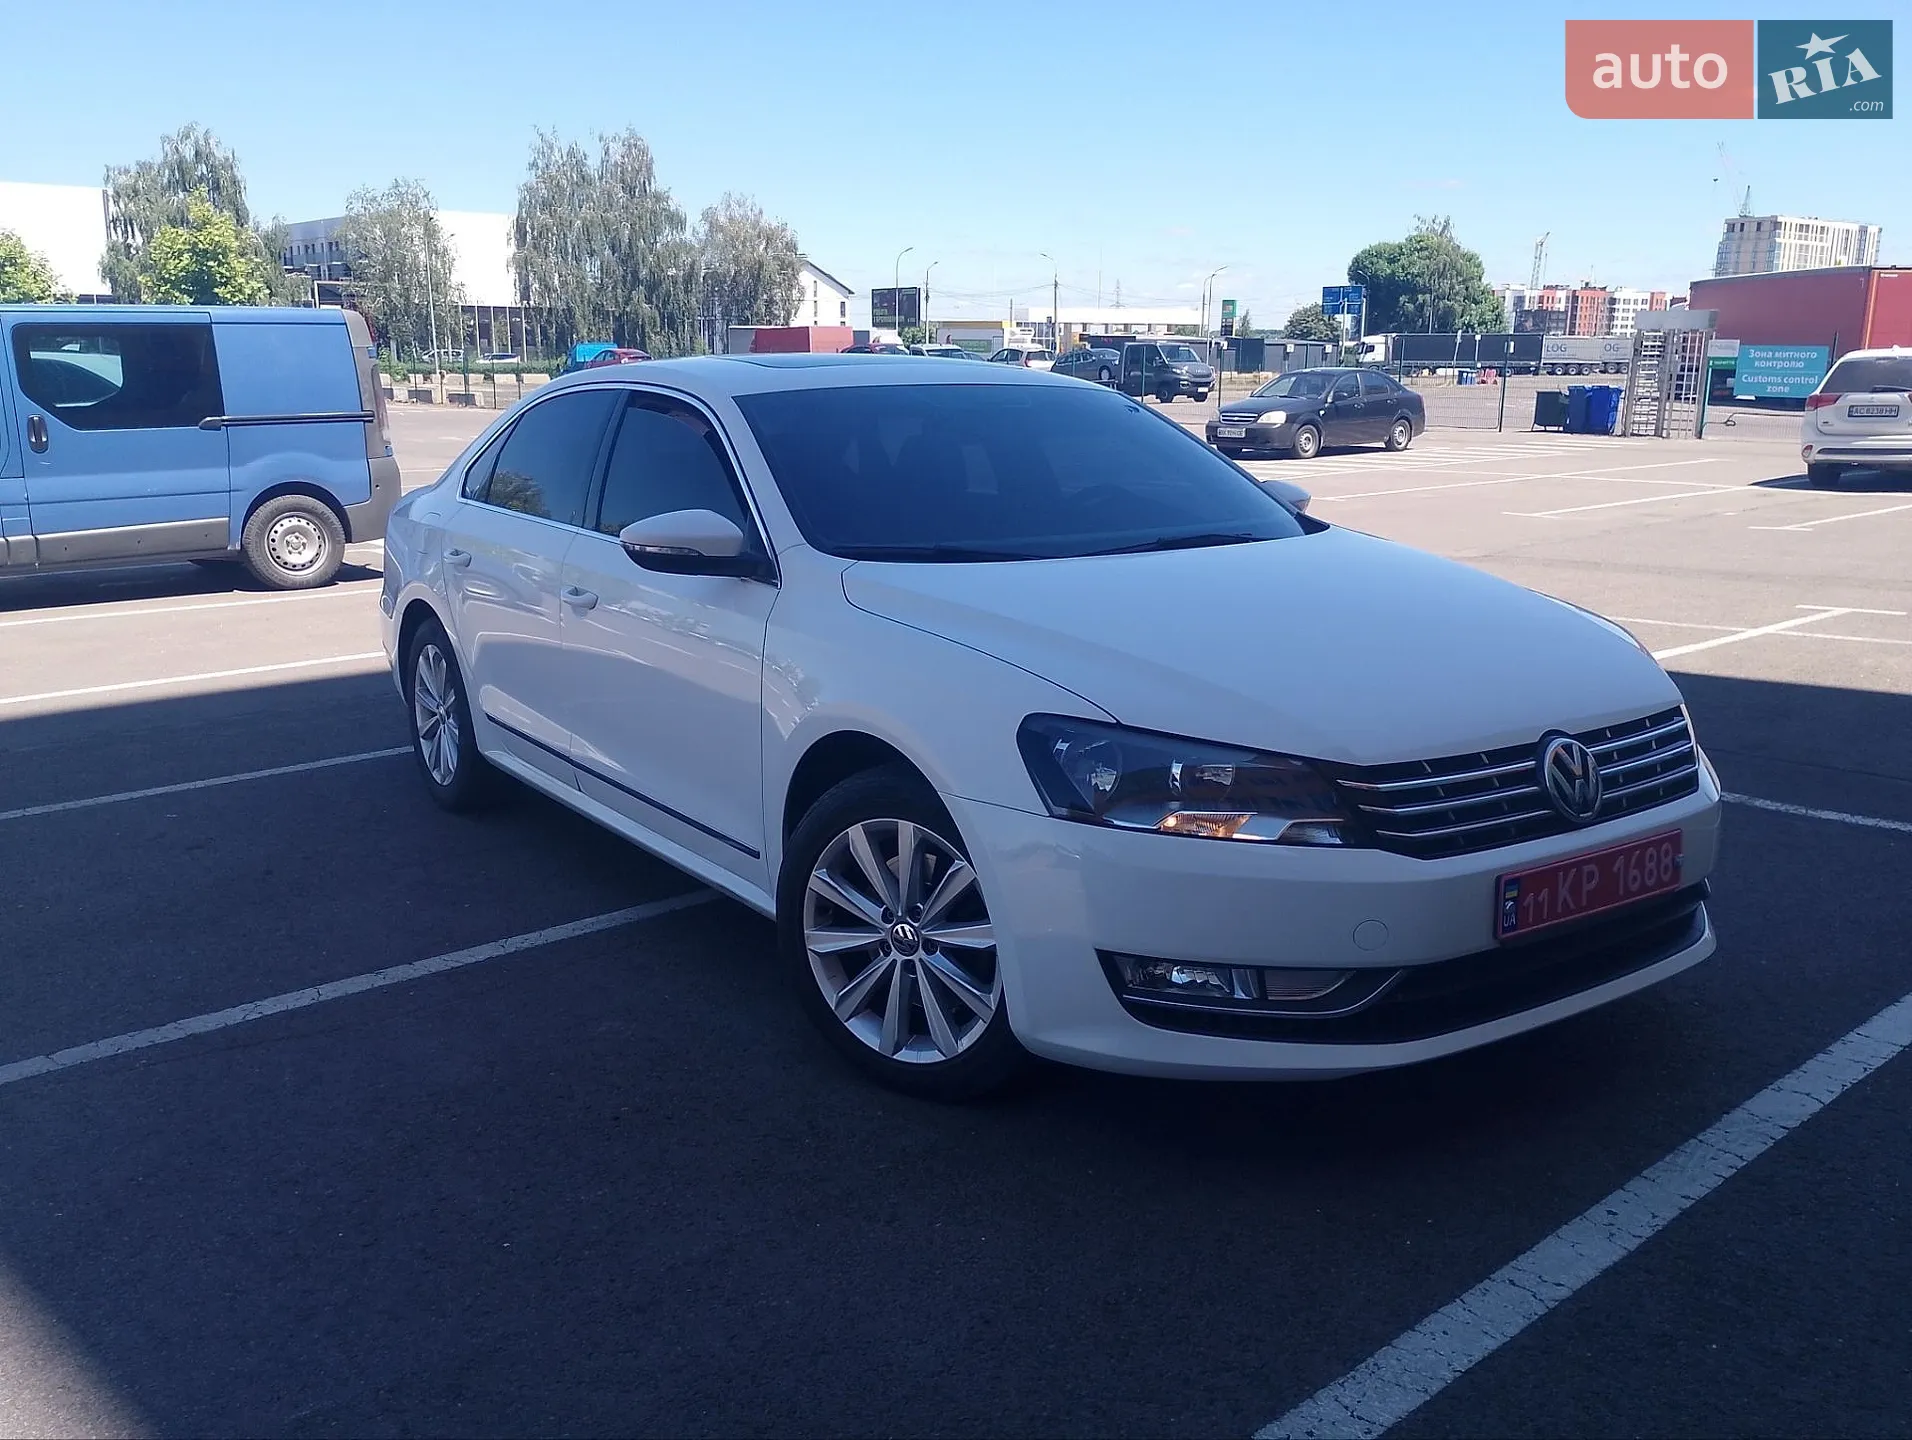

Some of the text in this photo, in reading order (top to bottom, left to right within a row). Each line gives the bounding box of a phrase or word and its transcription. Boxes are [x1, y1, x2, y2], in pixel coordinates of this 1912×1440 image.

[1546, 343, 1567, 353] LOG
[1748, 349, 1817, 359] Зона митного
[1754, 360, 1804, 369] контролю
[1742, 374, 1818, 385] Customs control
[1766, 385, 1790, 393] zone
[1523, 842, 1673, 923] 11 KP 1688
[1503, 913, 1516, 927] UA
